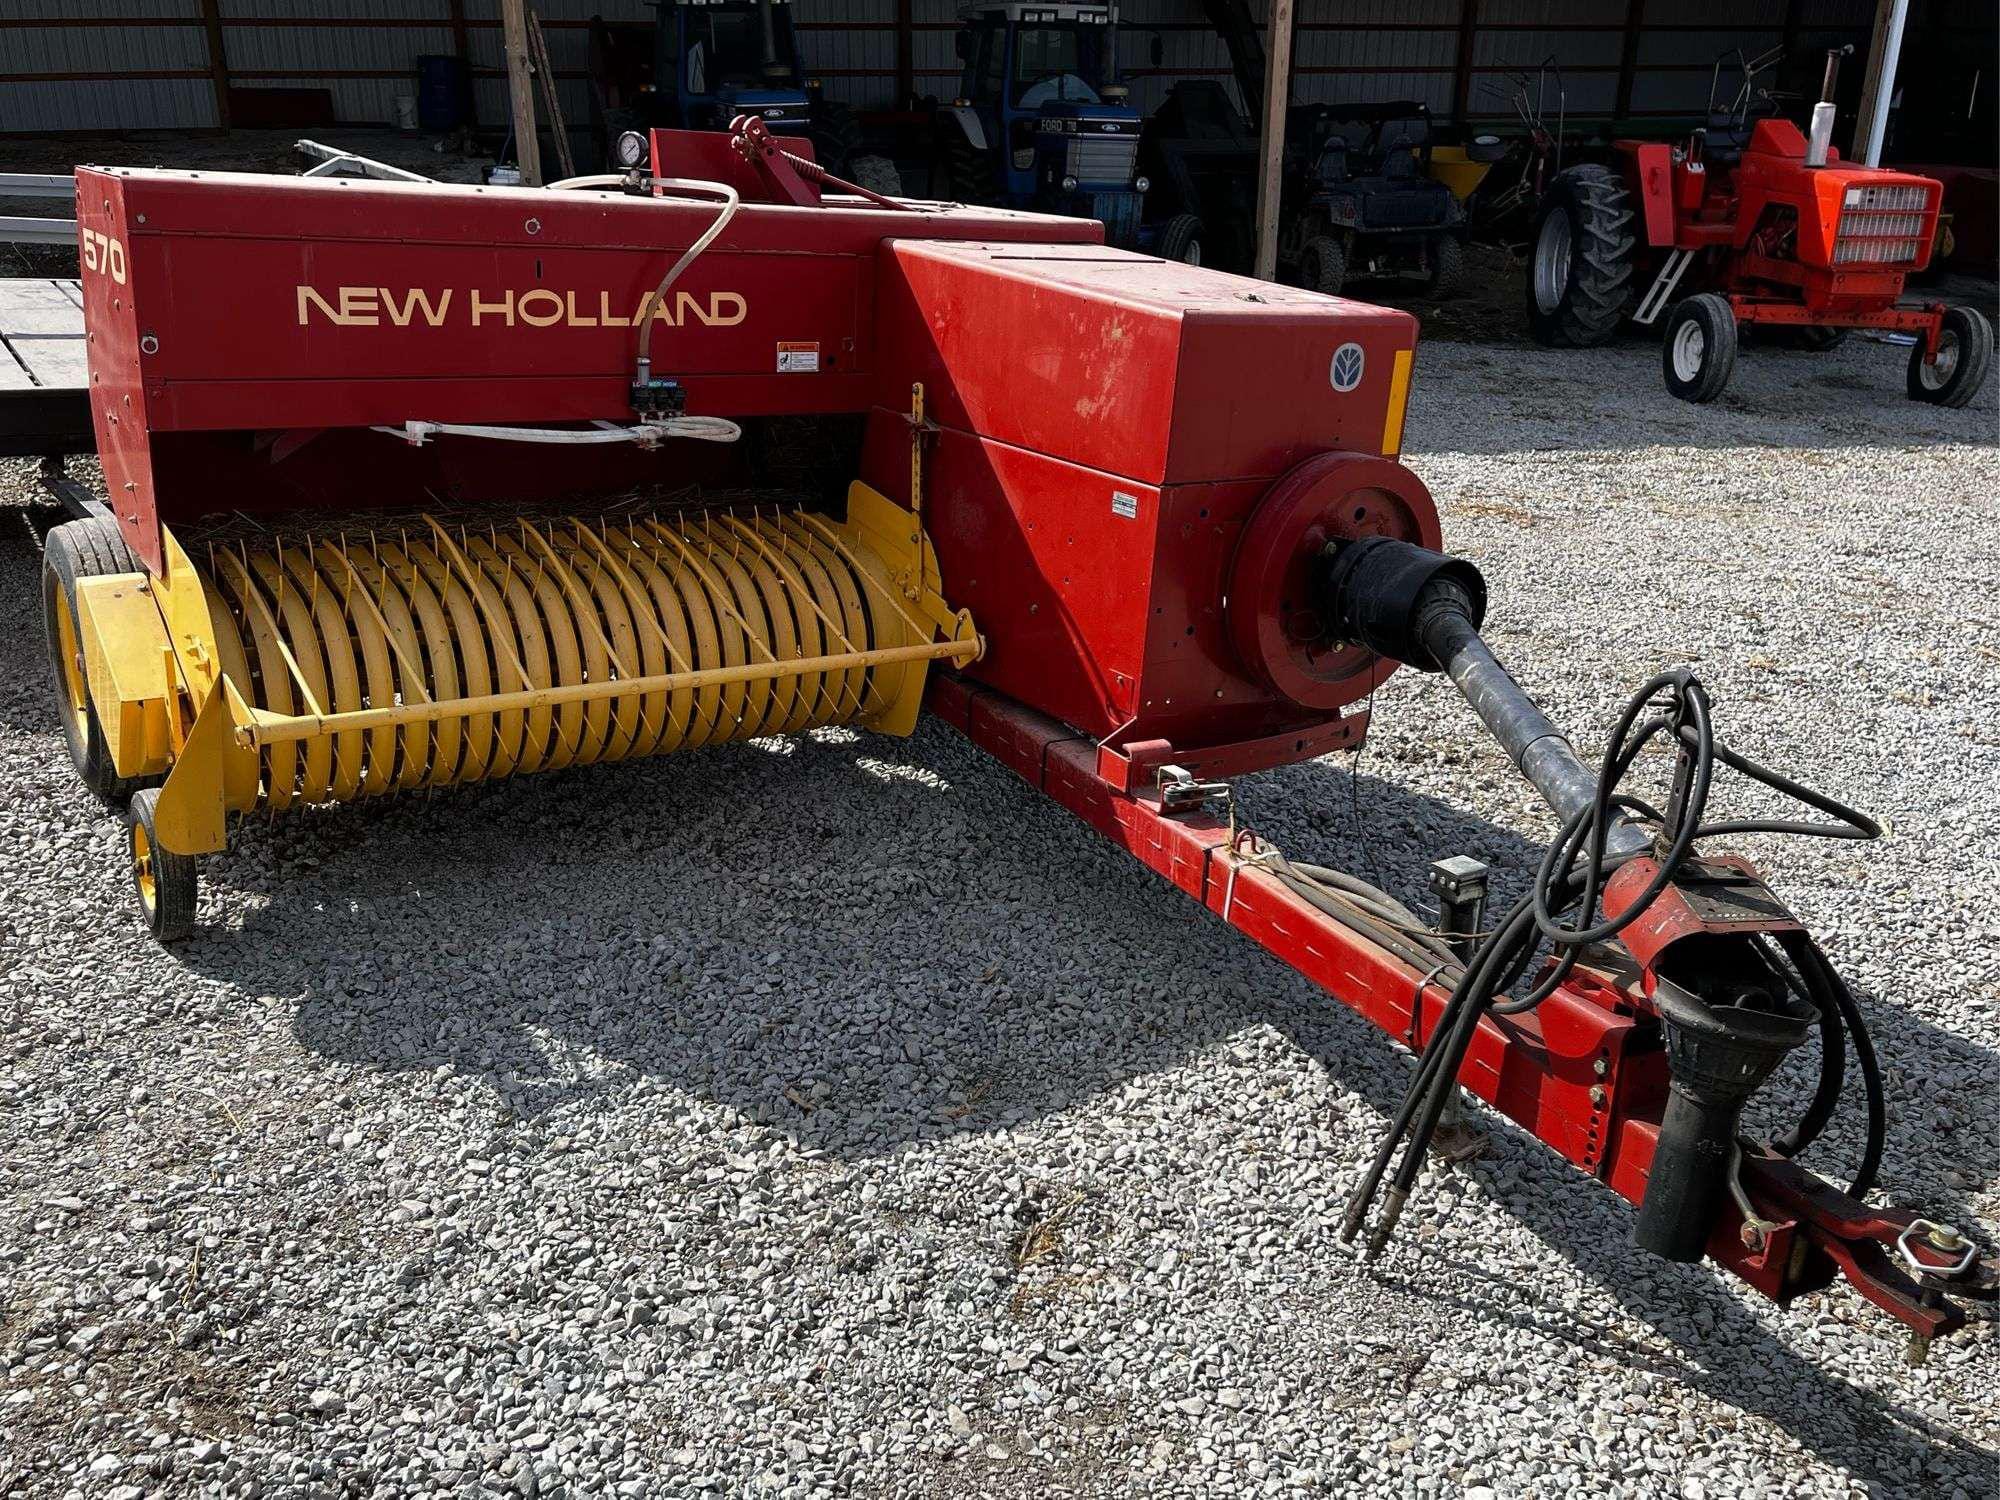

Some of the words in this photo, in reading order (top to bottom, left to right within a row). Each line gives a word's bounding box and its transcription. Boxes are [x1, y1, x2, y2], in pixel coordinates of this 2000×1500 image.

[1041, 119, 1063, 131] FORD
[82, 227, 126, 285] 570
[296, 286, 452, 326] NEW
[471, 289, 747, 326] HOLLAND
